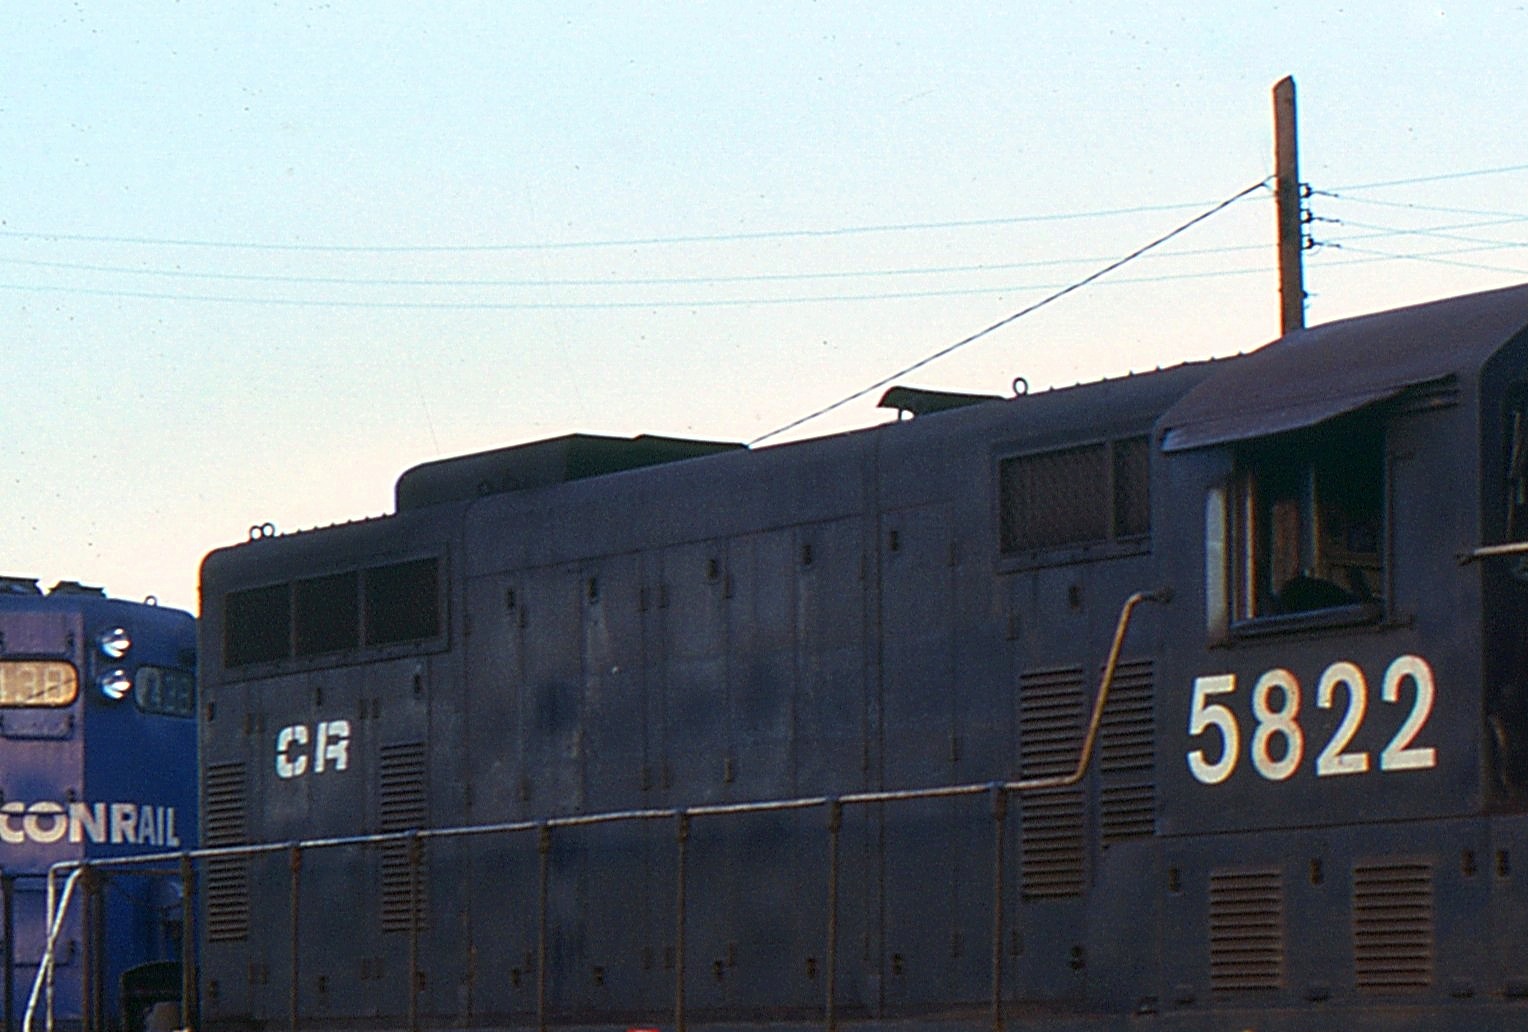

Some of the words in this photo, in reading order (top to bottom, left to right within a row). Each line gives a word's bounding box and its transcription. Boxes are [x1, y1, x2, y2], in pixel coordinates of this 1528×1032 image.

[276, 719, 350, 779] CR
[1187, 654, 1437, 784] 5822
[0, 801, 181, 848] CONRAIL
